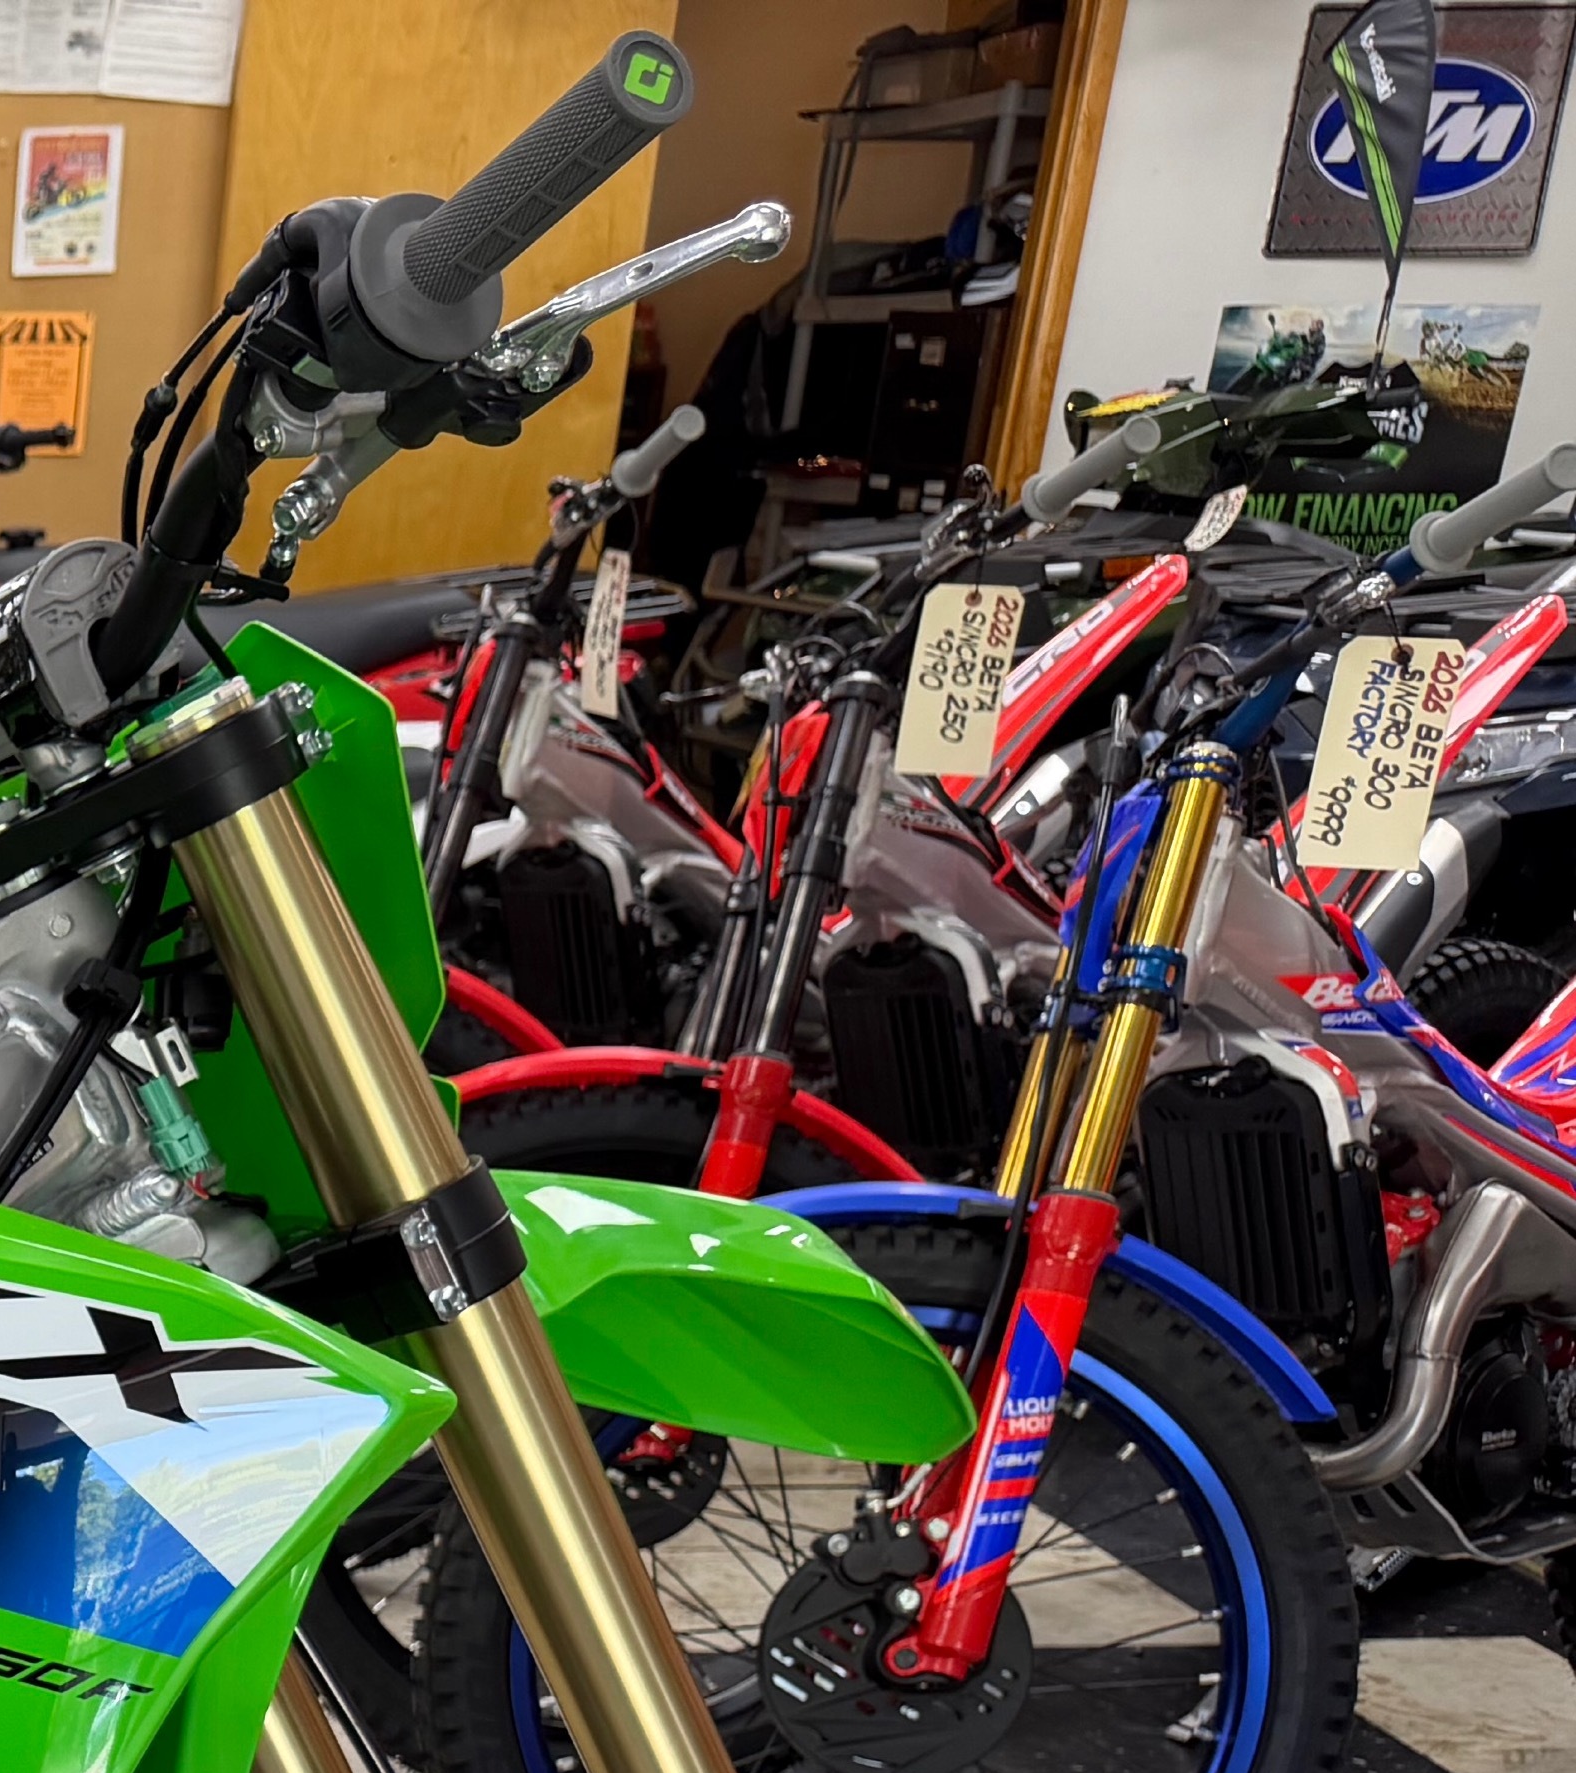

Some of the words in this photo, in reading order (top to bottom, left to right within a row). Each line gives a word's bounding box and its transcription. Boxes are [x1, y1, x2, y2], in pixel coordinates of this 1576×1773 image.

[951, 609, 987, 688] SINCRO
[986, 594, 1019, 649] 2026
[973, 655, 1005, 713] BETA
[1346, 659, 1396, 760] FACTORY
[1380, 667, 1426, 751] SINCRO
[1421, 650, 1465, 716] 2026
[940, 695, 969, 744] 250
[1364, 756, 1401, 811] 300
[1400, 723, 1444, 790] BETA
[1004, 1394, 1057, 1419] LIQU
